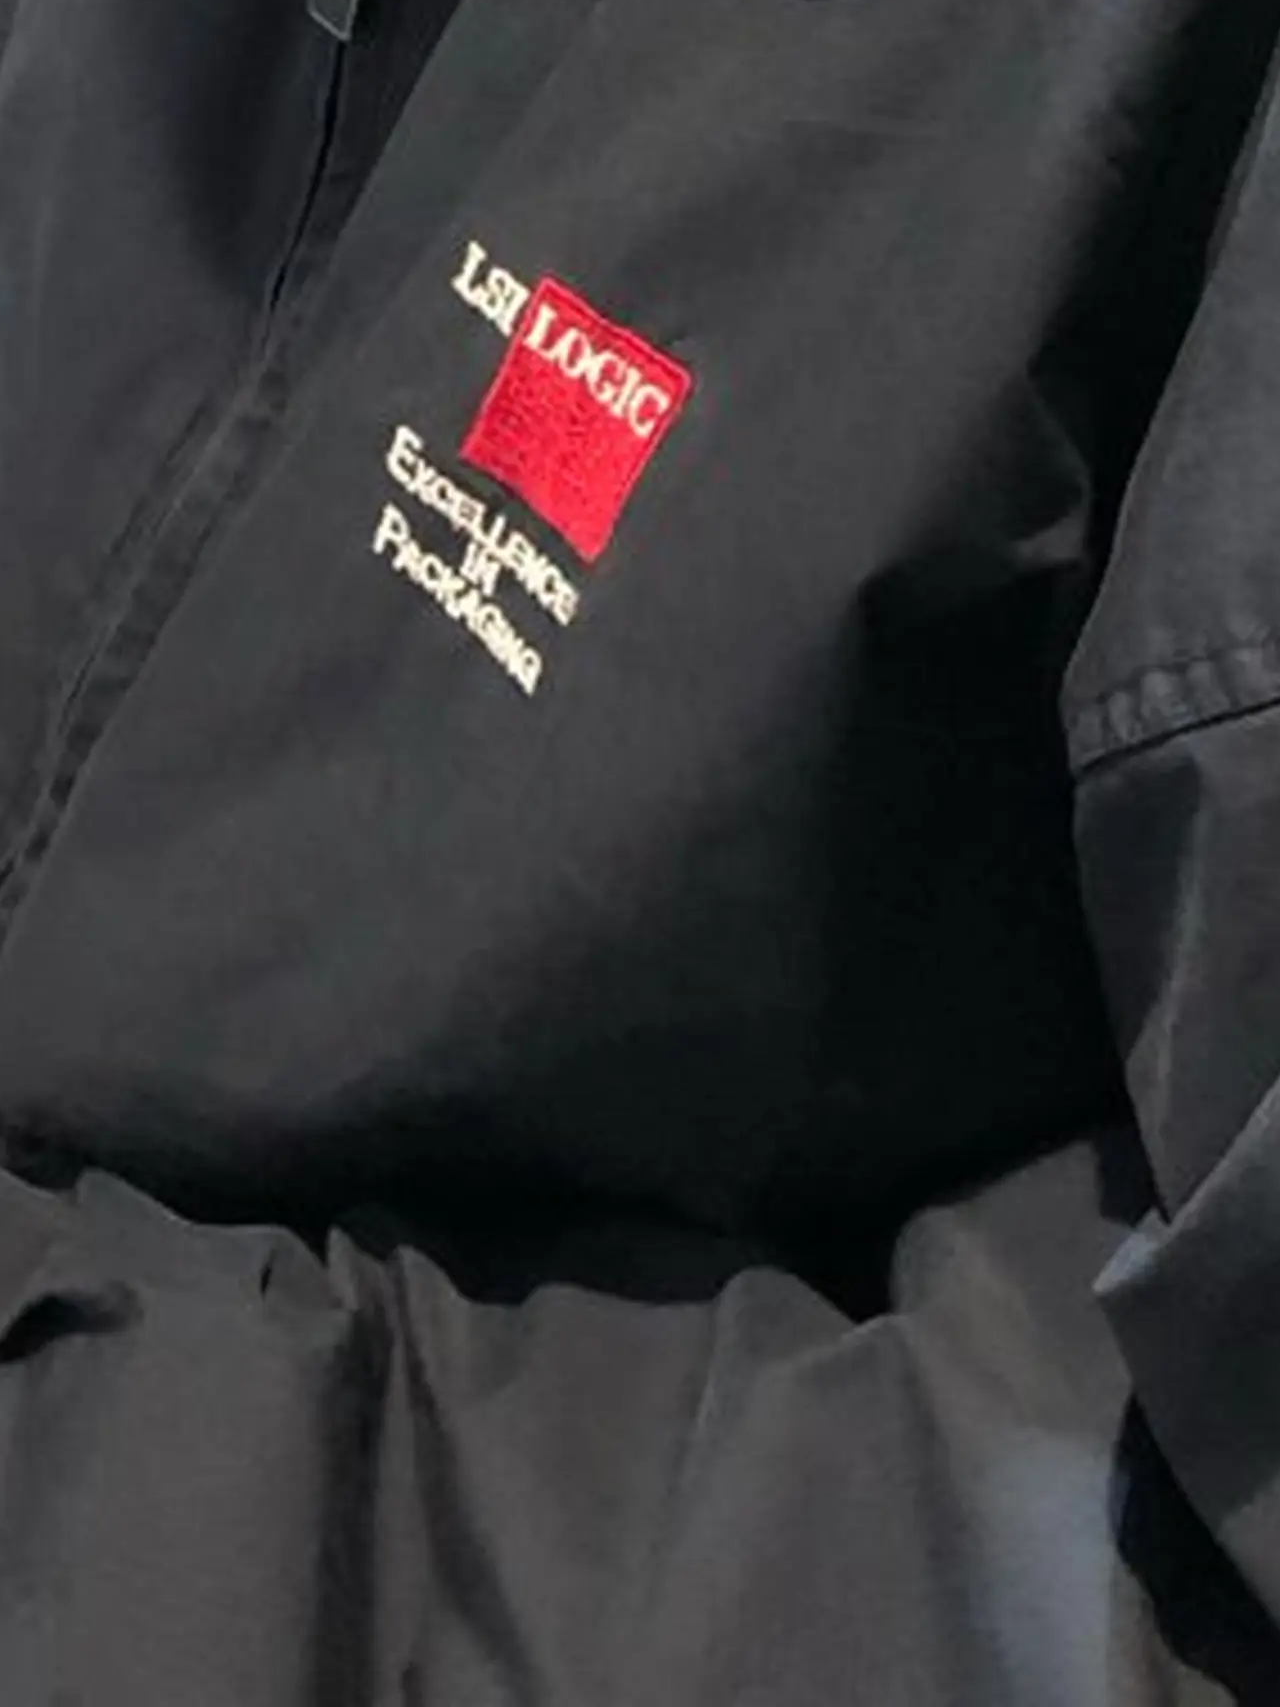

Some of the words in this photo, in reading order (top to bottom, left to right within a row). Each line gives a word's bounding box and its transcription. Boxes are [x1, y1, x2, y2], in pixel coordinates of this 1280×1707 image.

[451, 241, 531, 337] LSI
[524, 303, 669, 438] LOGIC
[372, 502, 543, 697] PACKAGING
[385, 424, 580, 626] EXCELLENCE
[460, 542, 501, 595] IN
